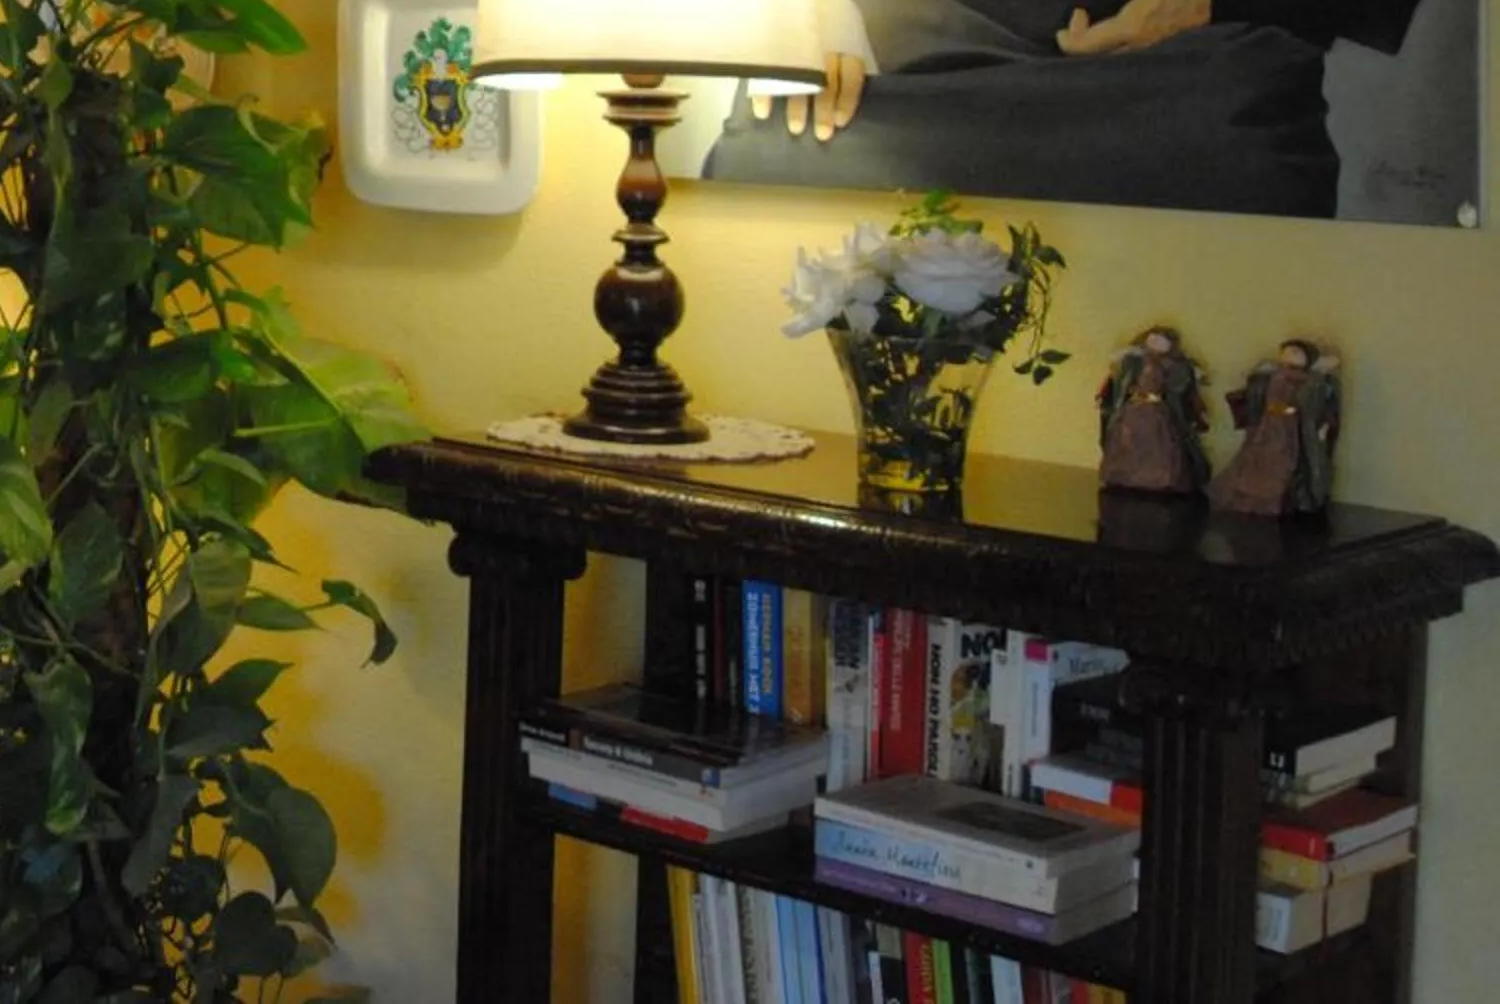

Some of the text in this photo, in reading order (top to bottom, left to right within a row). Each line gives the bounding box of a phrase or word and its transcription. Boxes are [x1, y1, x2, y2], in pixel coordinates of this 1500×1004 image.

[961, 627, 1007, 658] NO
[926, 644, 941, 778] NON HO PAROL
